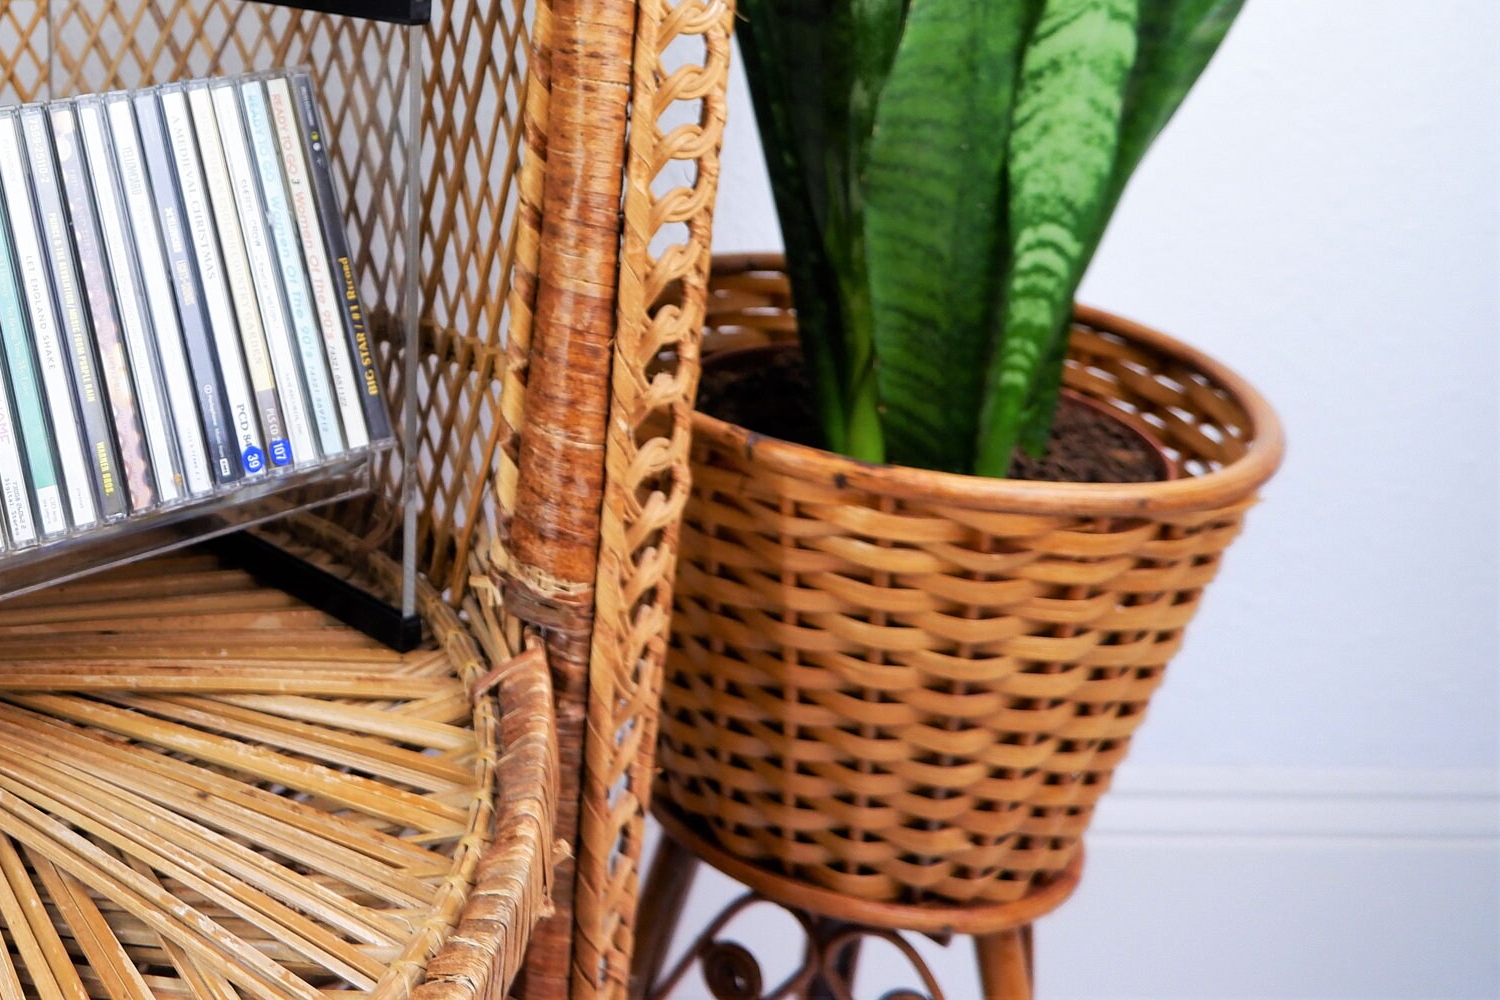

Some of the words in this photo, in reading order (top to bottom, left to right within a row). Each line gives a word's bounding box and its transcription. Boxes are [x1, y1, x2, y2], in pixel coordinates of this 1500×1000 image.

[272, 93, 287, 132] READY
[281, 136, 292, 150] TO
[285, 153, 297, 174] GO
[175, 127, 195, 192] MEDIEVAL
[192, 200, 215, 279] CHRISTMAS
[295, 192, 313, 247] Women
[308, 255, 320, 272] Of
[313, 279, 327, 304] The
[338, 257, 356, 300] Record
[25, 255, 35, 271] LET
[30, 278, 46, 329] ENGLAND
[42, 335, 55, 369] SHAKE
[321, 310, 334, 338] 90's
[356, 332, 371, 365] STAR
[364, 369, 378, 395] BIG
[246, 454, 259, 467] 39
[273, 443, 286, 459] 107
